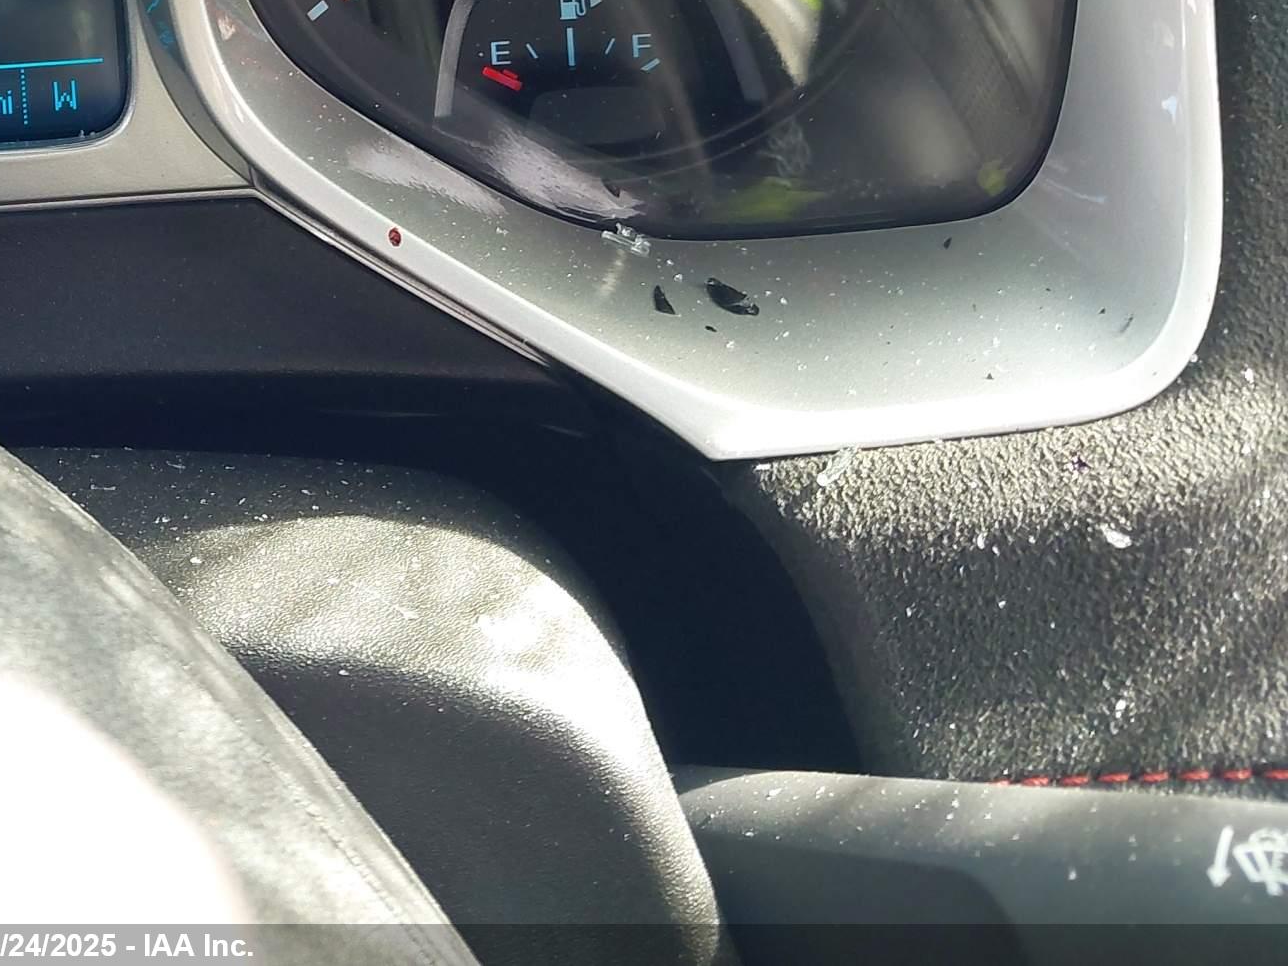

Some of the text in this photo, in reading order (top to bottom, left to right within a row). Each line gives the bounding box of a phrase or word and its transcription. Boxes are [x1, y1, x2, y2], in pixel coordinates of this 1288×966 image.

[490, 40, 511, 65] E
[631, 34, 653, 59] F
[53, 81, 78, 111] W
